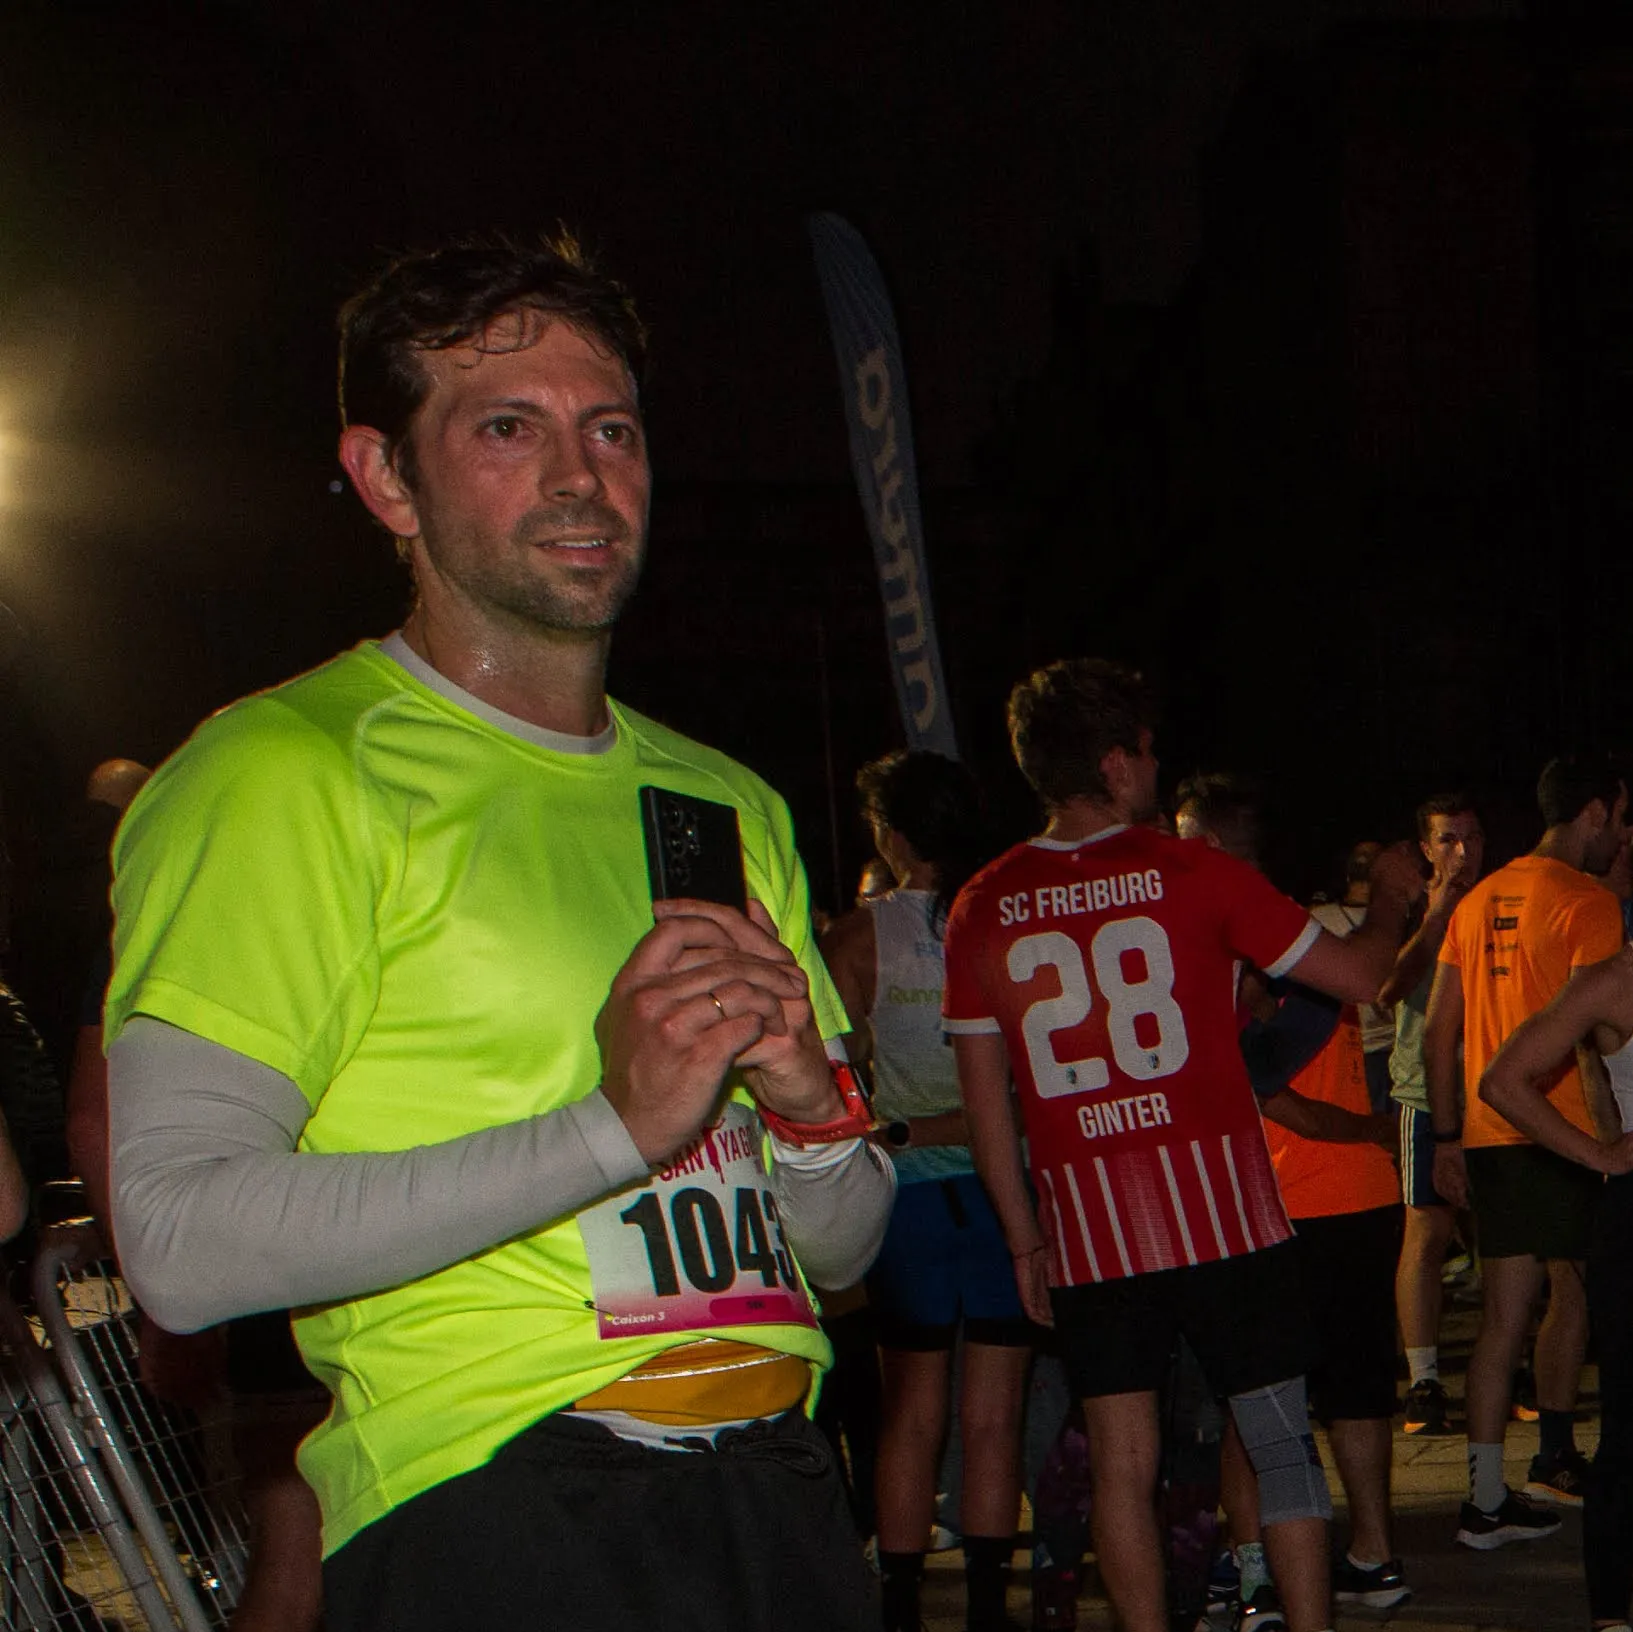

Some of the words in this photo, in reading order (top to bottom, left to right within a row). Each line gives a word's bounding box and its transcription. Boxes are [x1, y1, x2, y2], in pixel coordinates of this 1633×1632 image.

[999, 892, 1030, 926] SC
[1035, 869, 1163, 919] FREIBURG
[1007, 916, 1190, 1099] 28
[1077, 1092, 1172, 1139] GINTER
